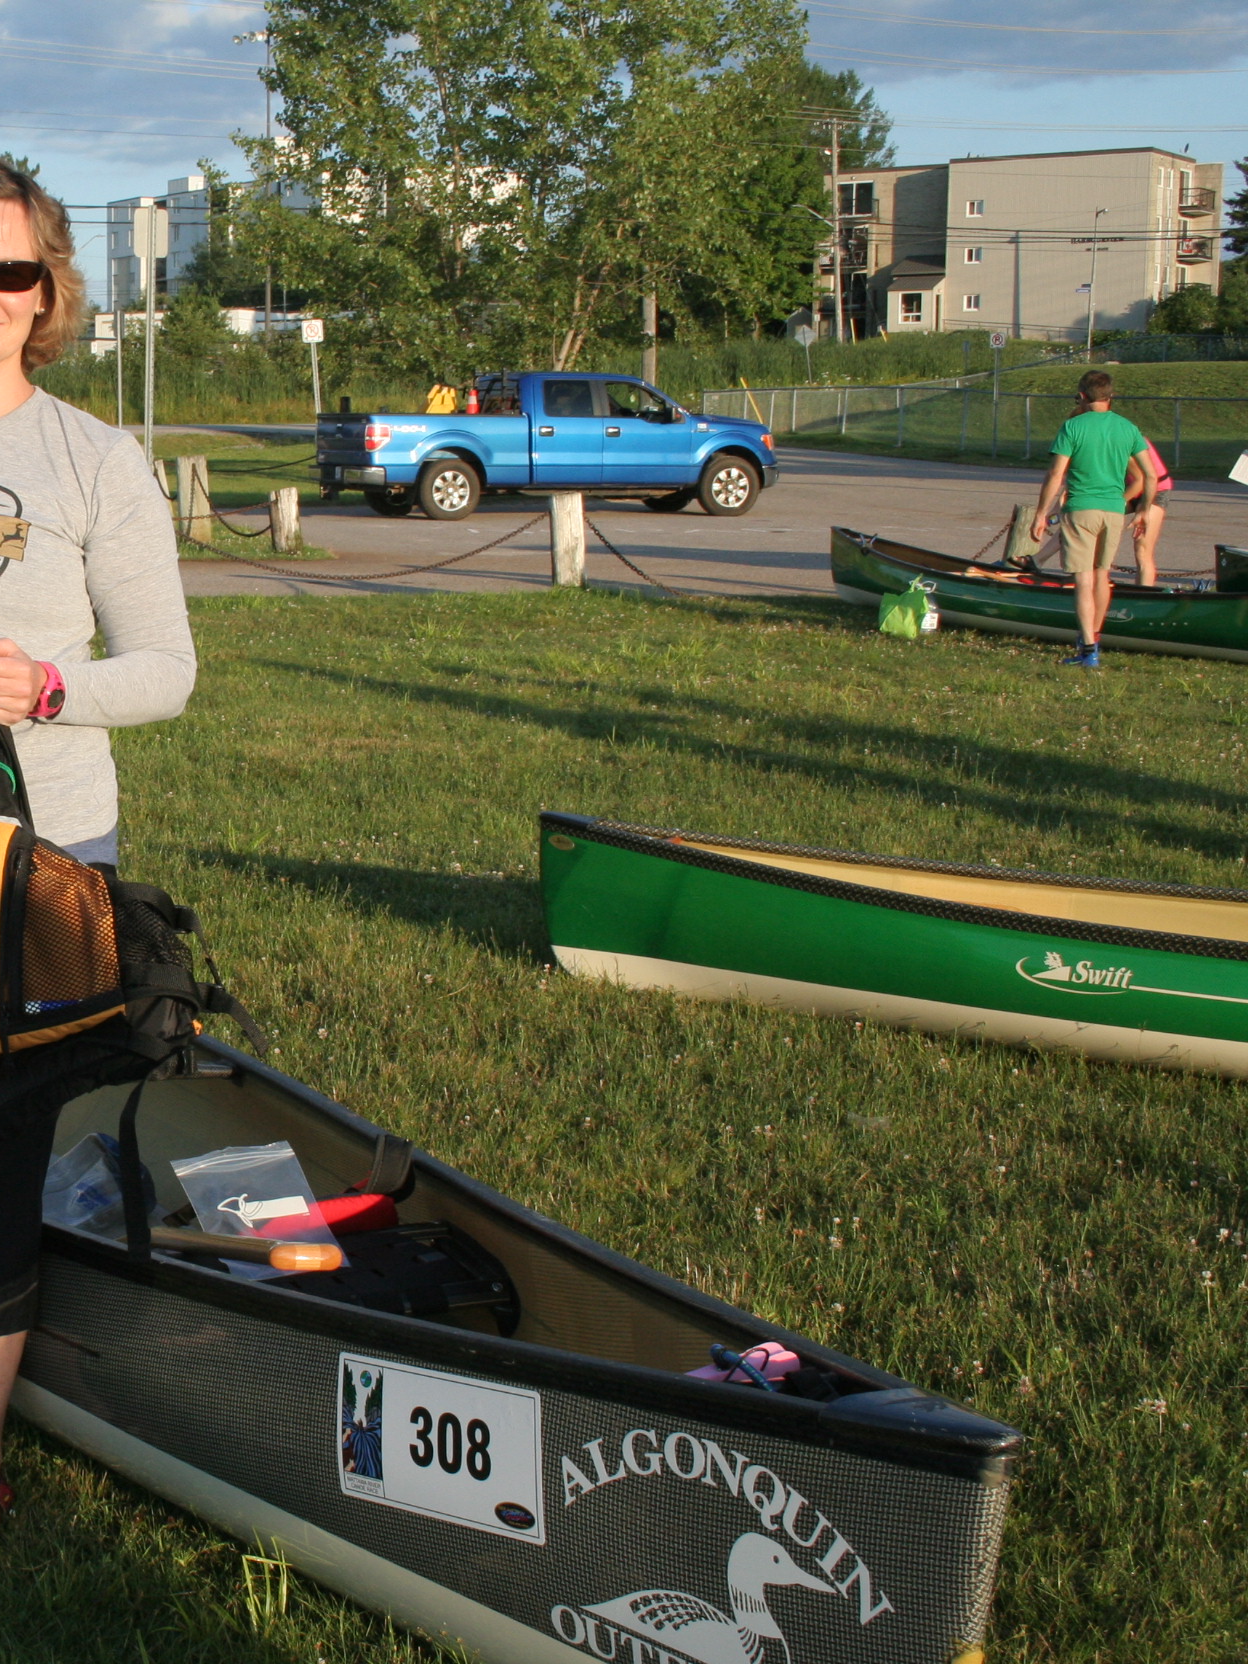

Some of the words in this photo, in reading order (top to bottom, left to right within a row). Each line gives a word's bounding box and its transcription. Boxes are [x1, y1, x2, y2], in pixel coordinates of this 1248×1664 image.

[1071, 960, 1133, 989] Swift
[409, 1406, 492, 1482] 308
[560, 1429, 895, 1626] ALGONQUIN
